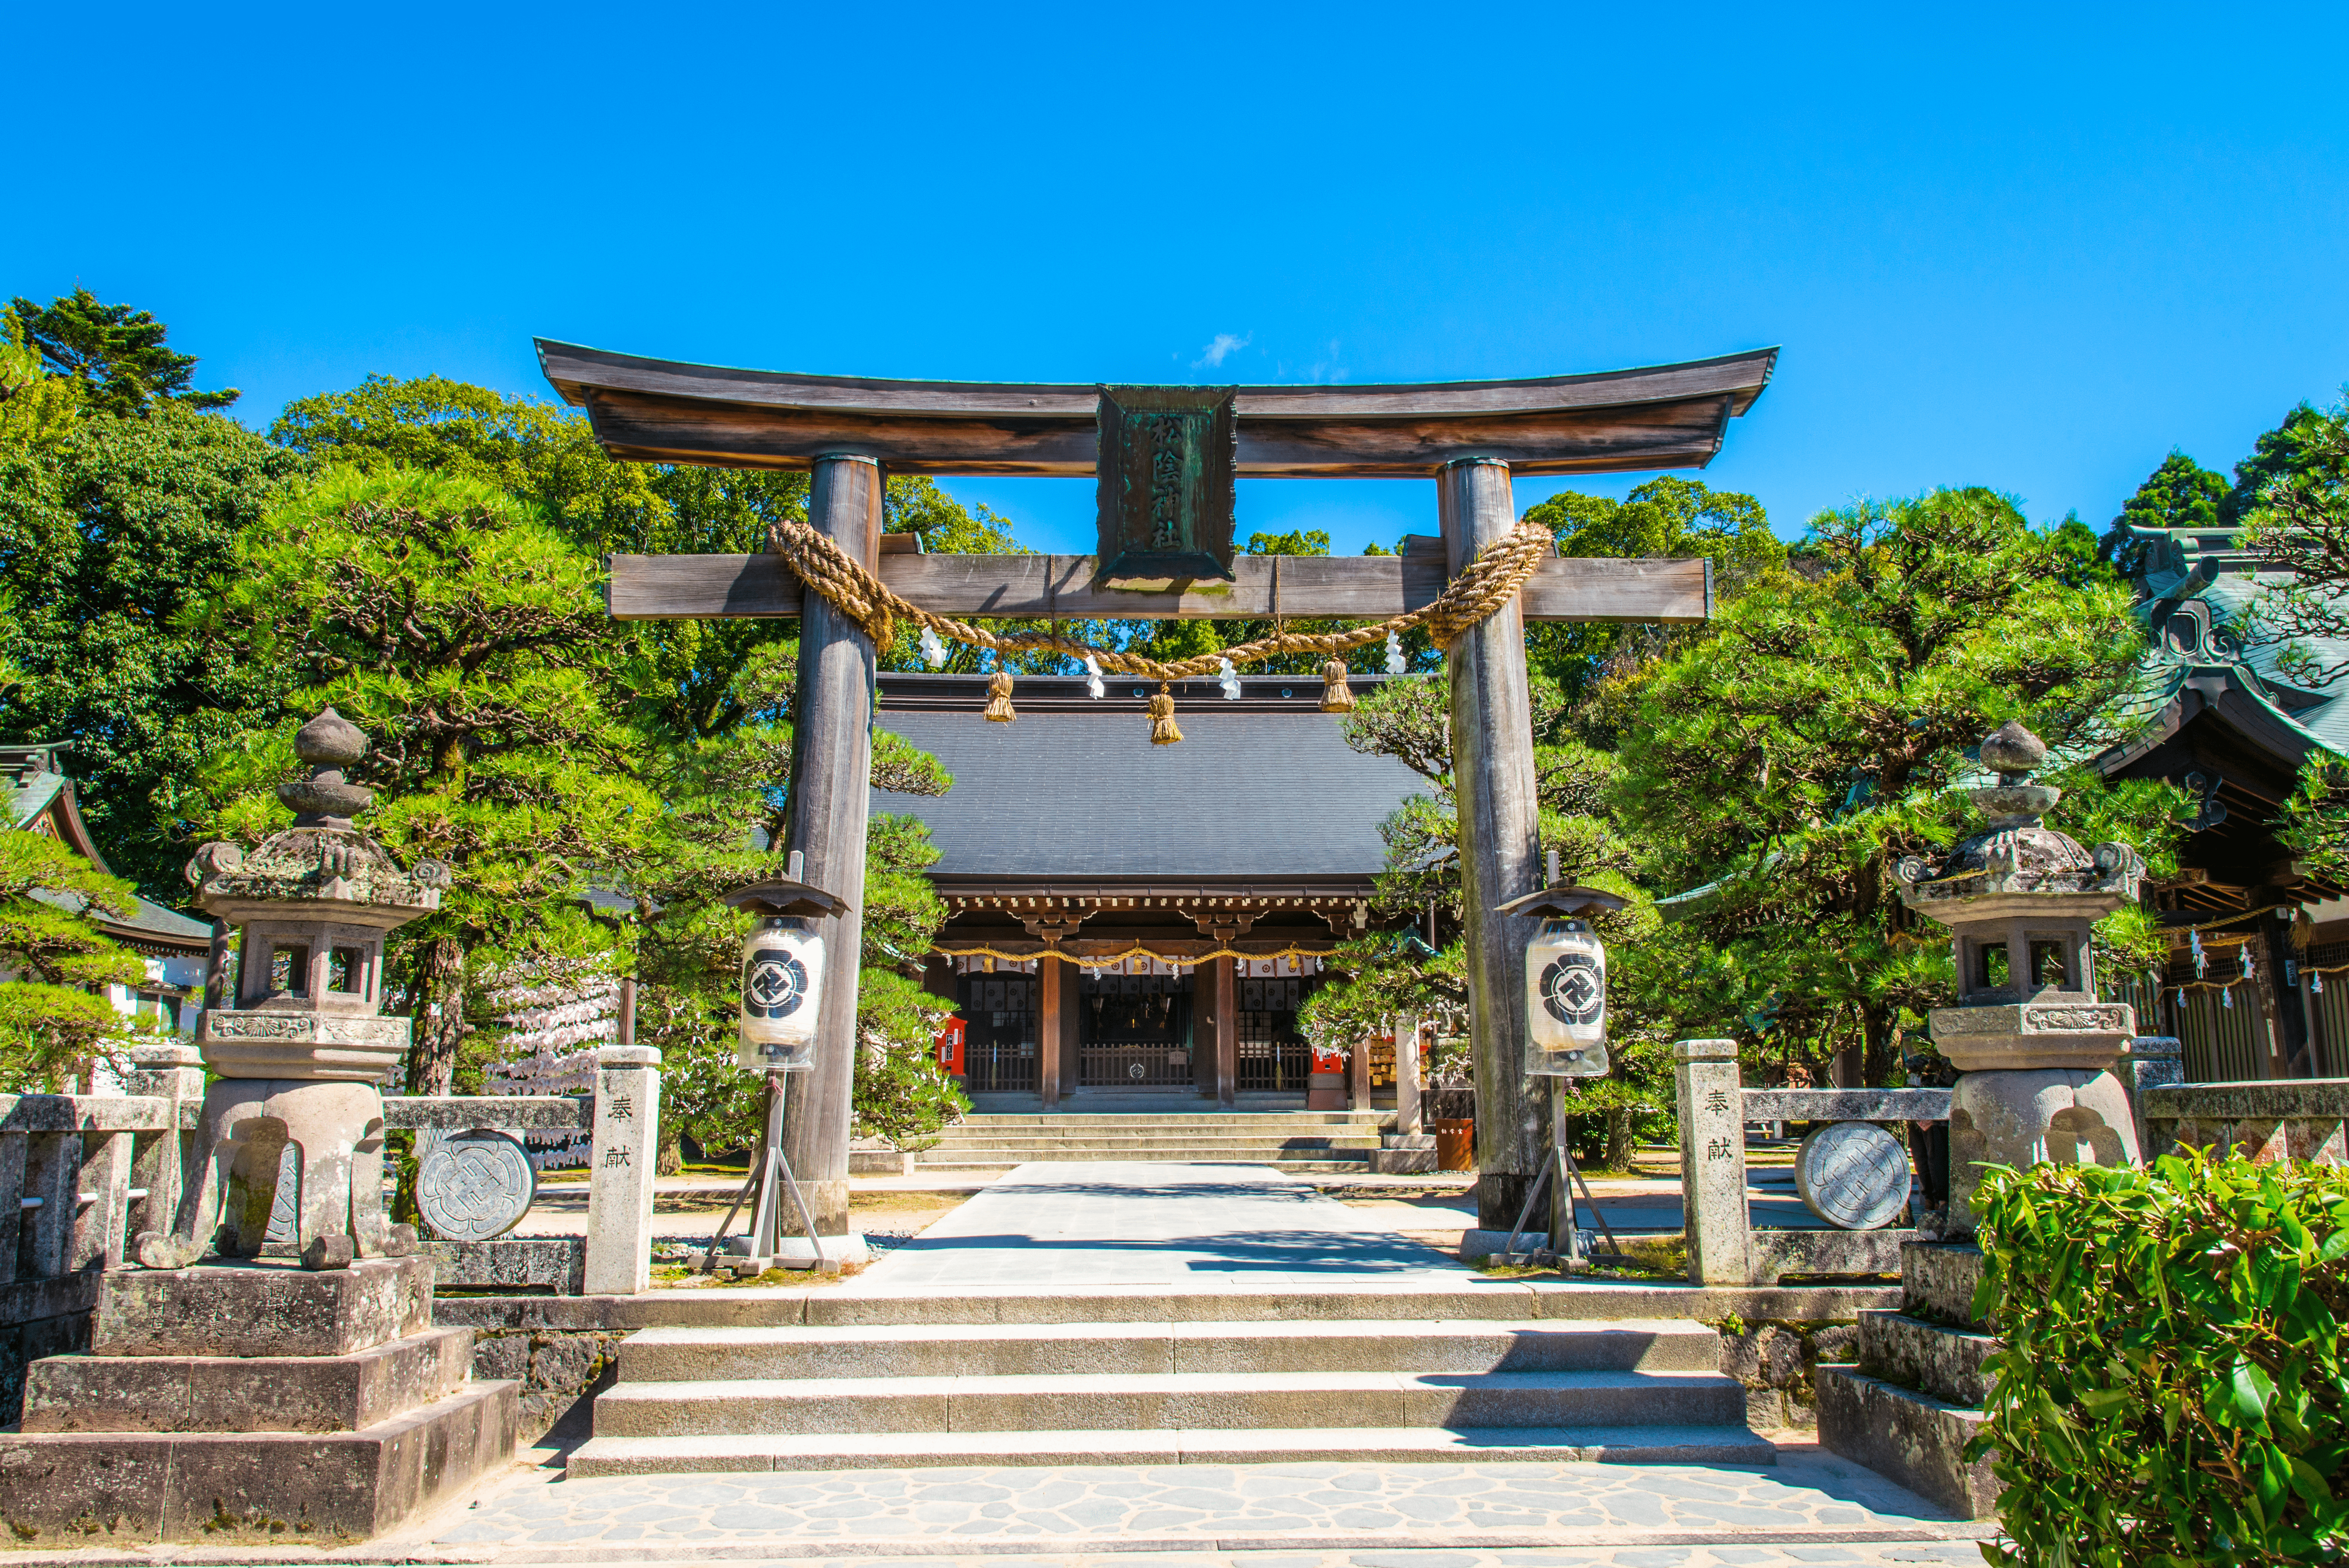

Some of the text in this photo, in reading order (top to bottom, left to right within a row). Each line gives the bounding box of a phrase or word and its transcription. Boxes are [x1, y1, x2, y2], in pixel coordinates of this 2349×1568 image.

[1151, 416, 1182, 549] 松陰神社
[605, 1096, 633, 1168] 奉献
[1705, 1089, 1732, 1160] 奉献
